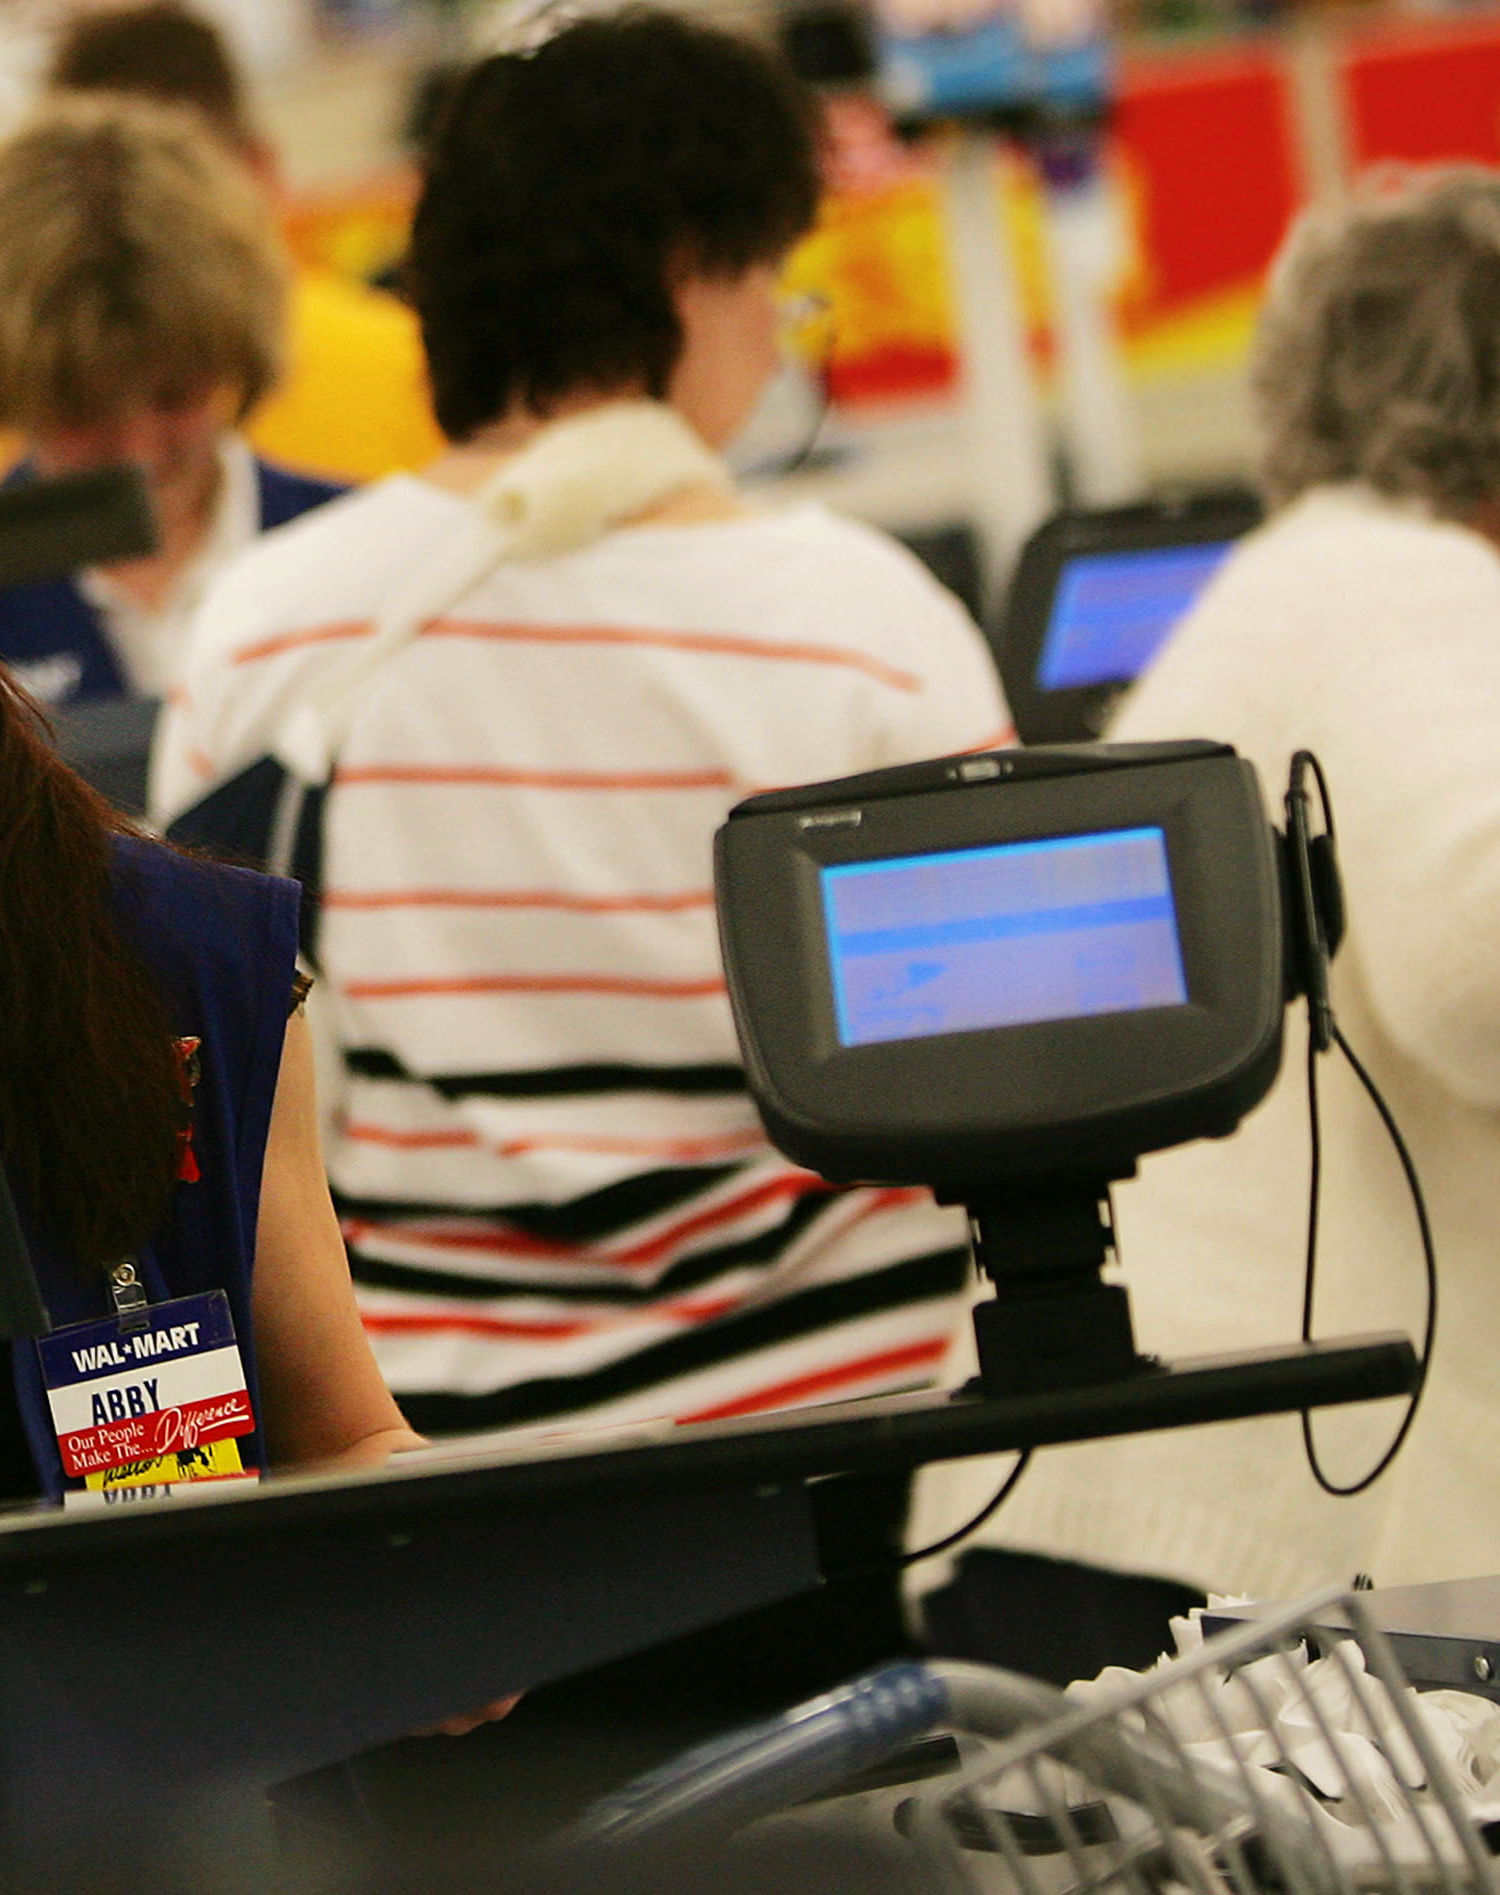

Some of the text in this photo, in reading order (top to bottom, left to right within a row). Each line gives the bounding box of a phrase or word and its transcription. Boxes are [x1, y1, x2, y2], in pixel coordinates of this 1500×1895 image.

[91, 1377, 162, 1427] ABBY
[67, 1420, 147, 1454] Our People
[69, 1449, 113, 1472] Make
[112, 1441, 155, 1462] The...
[153, 1396, 248, 1455] Difference
